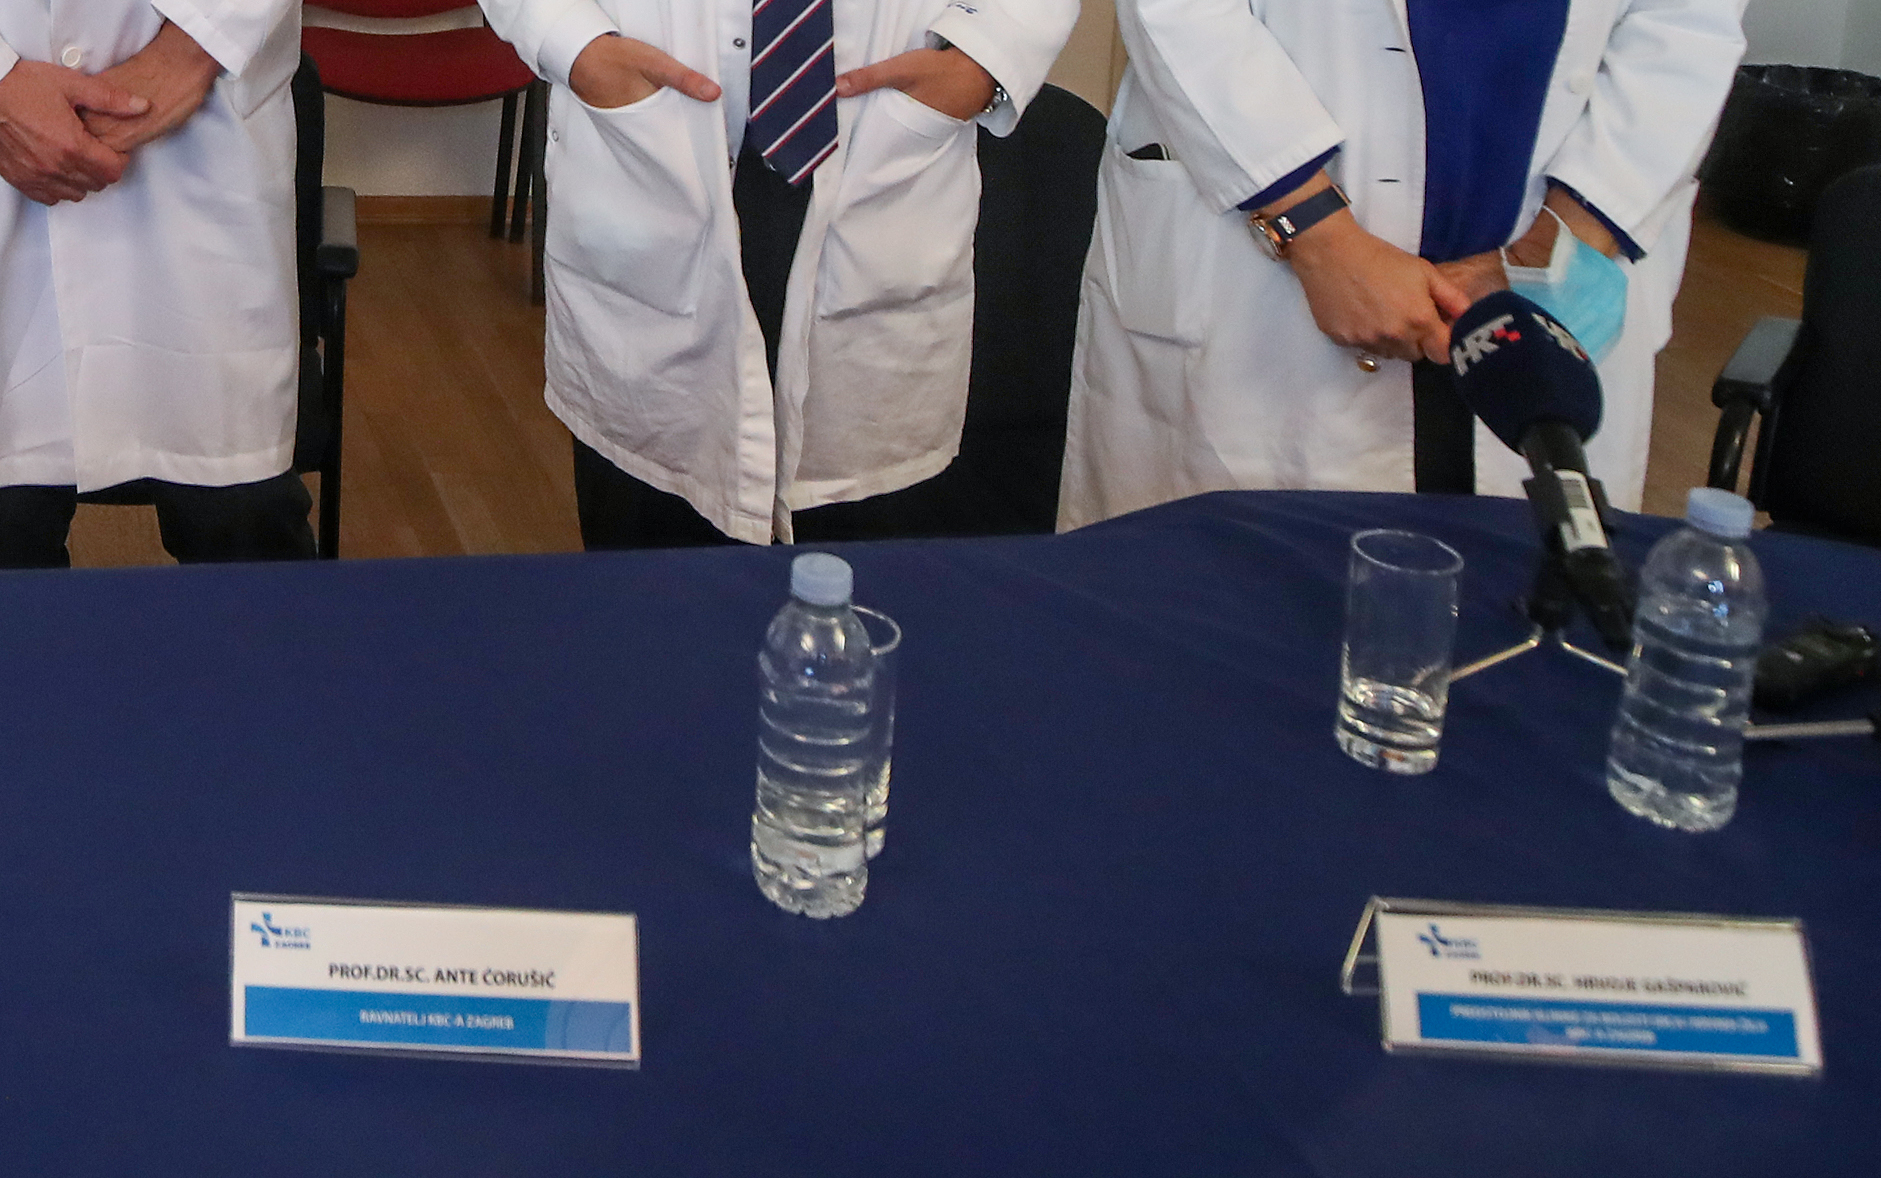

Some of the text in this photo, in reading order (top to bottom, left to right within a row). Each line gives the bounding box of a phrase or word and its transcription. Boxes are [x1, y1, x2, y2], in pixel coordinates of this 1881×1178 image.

[1451, 313, 1520, 376] HRT
[435, 968, 478, 984] ANTE
[482, 968, 556, 990] ĆORUŠIĆ
